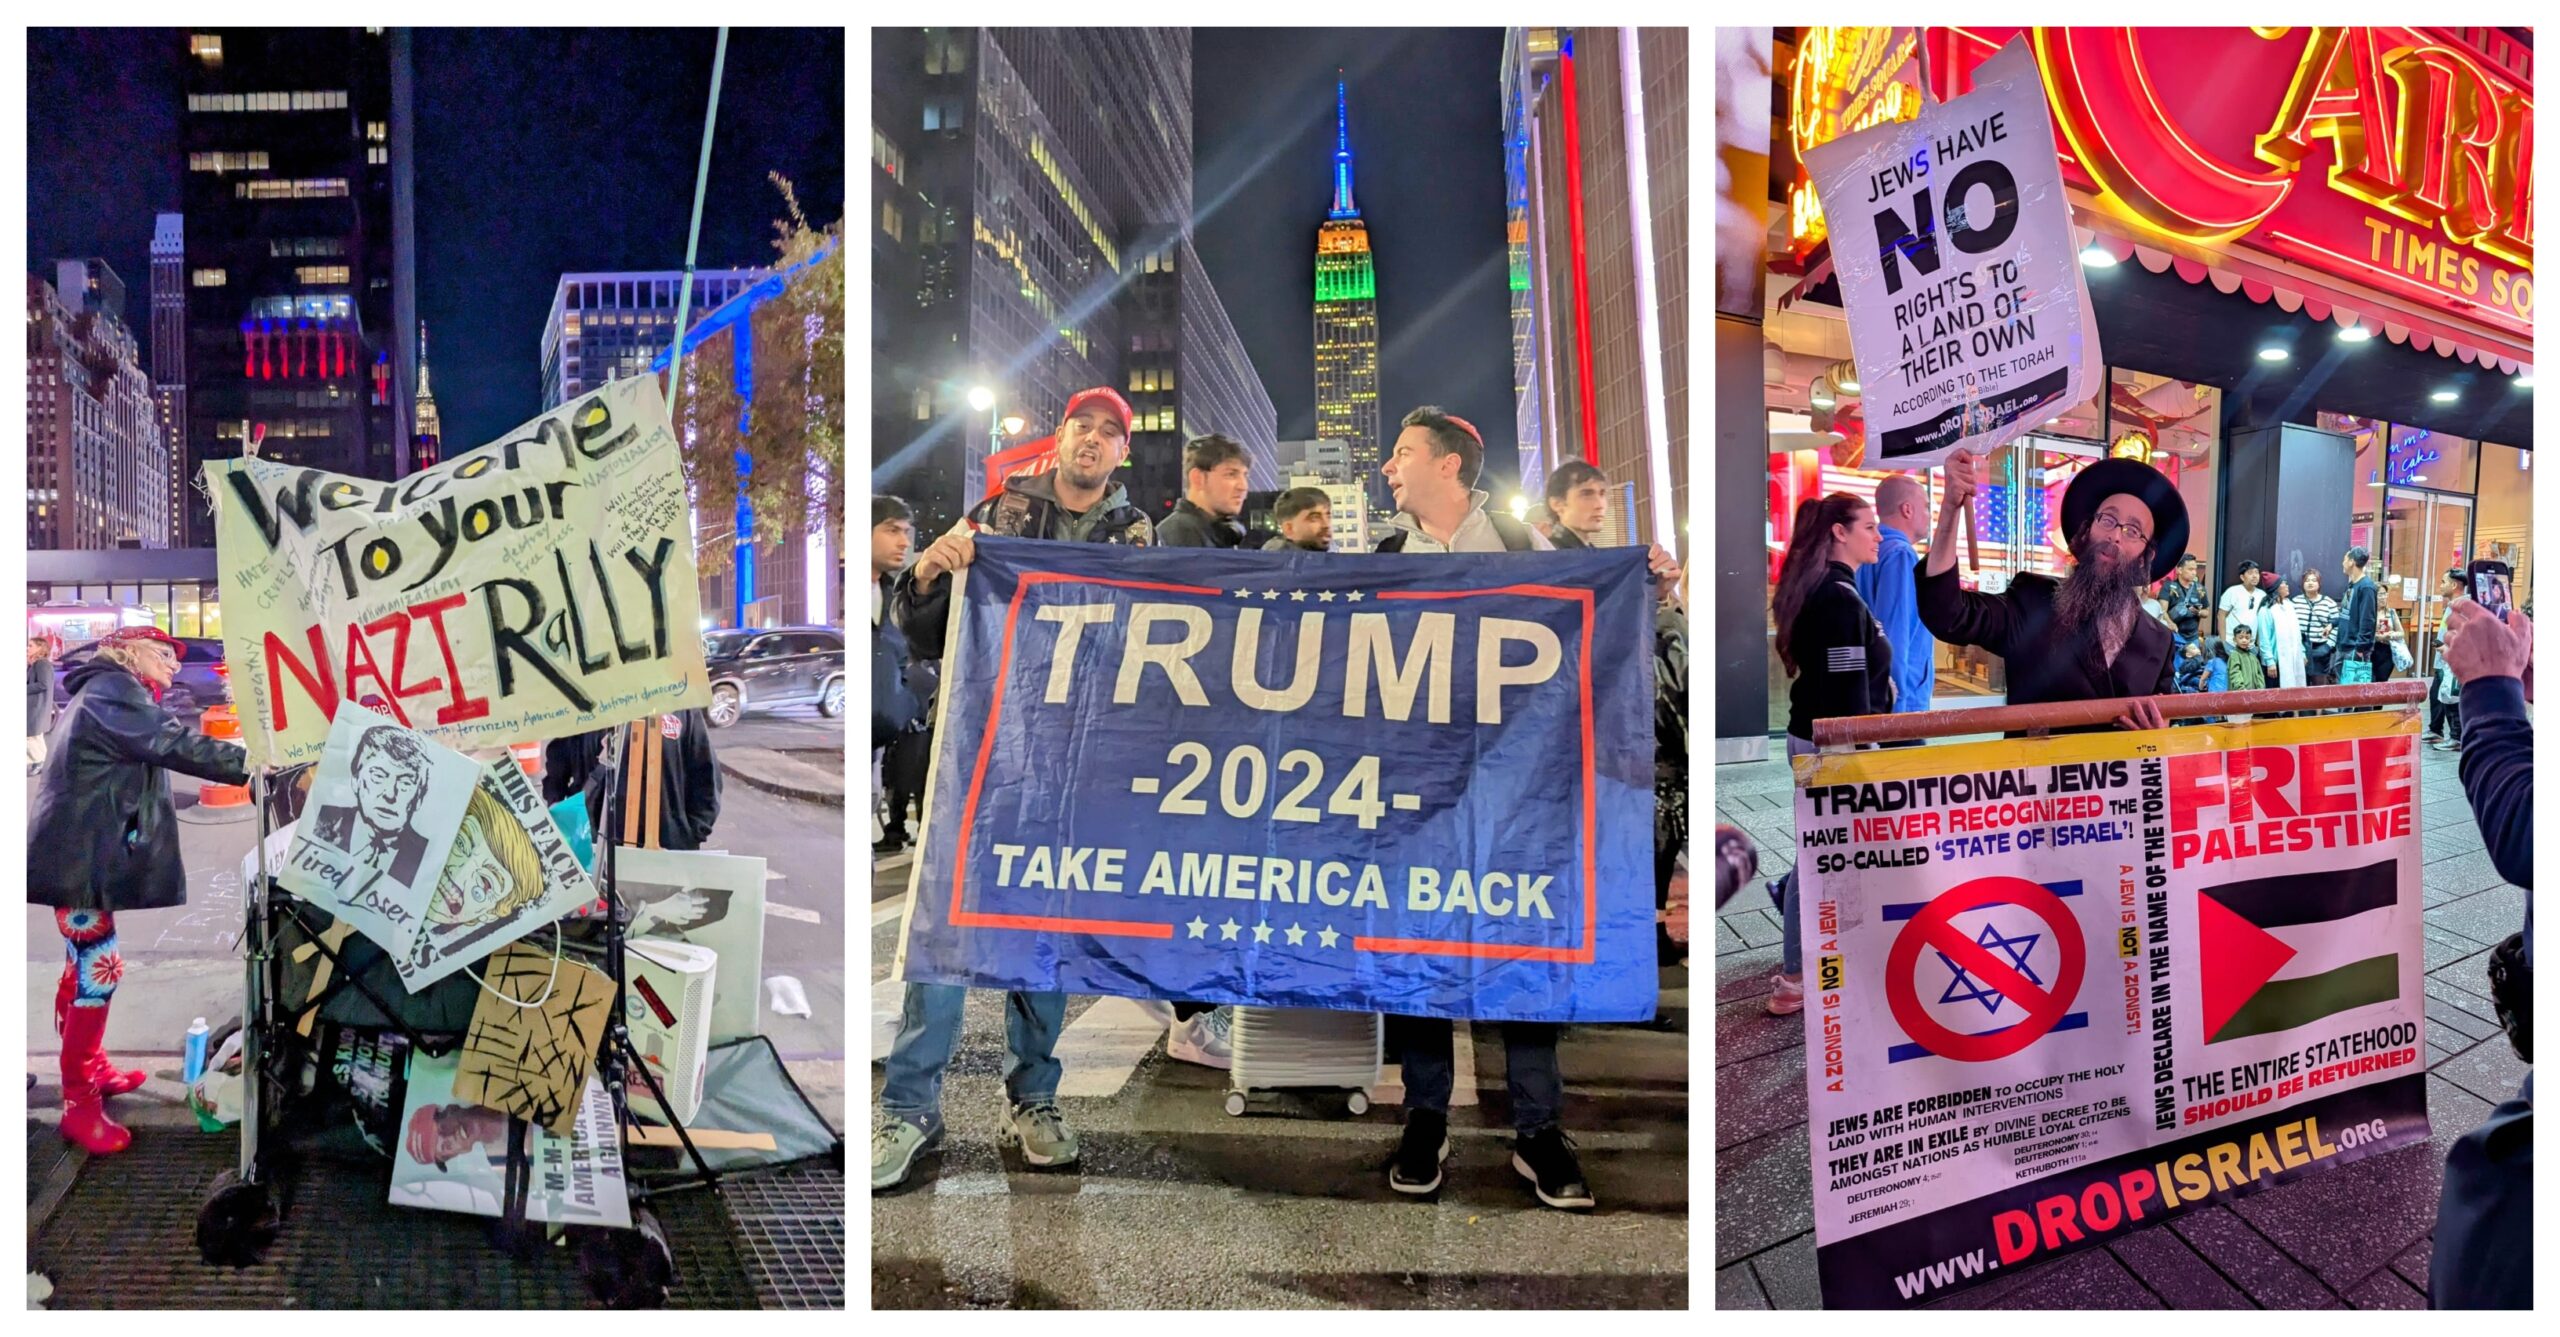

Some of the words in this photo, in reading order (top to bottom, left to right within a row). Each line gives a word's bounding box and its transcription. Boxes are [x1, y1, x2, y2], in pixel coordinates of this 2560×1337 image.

[1868, 149, 1930, 203] JEWS
[1936, 112, 2008, 166] HAVE
[1873, 159, 2019, 296] NO
[2364, 216, 2479, 294] TIMES
[1894, 271, 1977, 331] RIGHTS
[1986, 259, 2018, 289] TO
[1901, 333, 1914, 360] A
[1918, 303, 1985, 349] LAND
[1994, 285, 2027, 319] OF
[1900, 339, 1964, 388] THEIR
[1972, 314, 2036, 358] OWN
[1892, 378, 1955, 417] ACCORDING
[1958, 372, 1975, 388] TO
[1978, 362, 2008, 383] THE
[2010, 344, 2054, 374] TORAH
[226, 395, 640, 552] Welcome
[2402, 448, 2441, 473] cake
[605, 493, 626, 513] Will
[317, 526, 402, 600] To
[400, 479, 583, 593] your
[235, 557, 269, 589] HATE
[240, 637, 272, 731] MISOGYNY
[262, 592, 489, 732] NAZI
[1034, 602, 1563, 724] TRUMP
[456, 718, 519, 737] terrorizing
[523, 707, 570, 727] Americans
[640, 672, 689, 702] democracy
[284, 747, 303, 760] We
[1131, 741, 1422, 830] -2024-
[1805, 769, 2038, 817] TRADITIONAL
[2047, 761, 2129, 793] JEWS
[2140, 757, 2164, 824] TORAH:
[2168, 734, 2413, 834] FREE
[493, 750, 540, 816] THIS
[530, 817, 586, 891] FACE
[1803, 827, 1848, 849] HAVE
[1853, 811, 1941, 843] NEVER
[1949, 794, 2104, 838] RECOGNIZED
[2109, 798, 2138, 816] THE
[2143, 827, 2165, 863] THE
[2171, 805, 2411, 870] PALESTINE
[289, 835, 353, 890] Tired
[1817, 846, 1930, 874] SO-CALLED
[2016, 828, 2045, 849] OF
[2119, 864, 2134, 876] A
[2145, 865, 2168, 889] OF
[993, 843, 1128, 893] TAKE
[1139, 850, 1390, 910] AMERICA
[1408, 867, 1555, 920] BACK
[2119, 878, 2136, 908] JEW
[1818, 899, 1837, 936] JEW!
[1820, 939, 1838, 951] A
[2120, 909, 2137, 924] IS
[2121, 926, 2138, 957] NOT
[2146, 890, 2169, 944] NAME
[1821, 954, 1840, 991] NOT
[2123, 961, 2139, 972] A
[2149, 944, 2170, 982] THE
[1822, 993, 1841, 1010] IS
[2123, 975, 2142, 1036] ZIONIST!
[2150, 983, 2172, 1004] IN
[1823, 1014, 1843, 1078] ZIONIST
[2151, 1004, 2175, 1085] DECLARE
[2182, 1071, 2225, 1102] THE
[2231, 1051, 2300, 1092] ENTIRE
[2305, 1021, 2417, 1070] STATEHOOD
[1826, 1079, 1844, 1093] A
[1827, 1112, 1868, 1138] JEWS
[1872, 1104, 1903, 1127] ARE
[1907, 1085, 1992, 1118] FORBIDDEN
[1995, 1086, 2012, 1098] TO
[2015, 1074, 2064, 1095] OCCUPY
[2067, 1070, 2091, 1084] THE
[2094, 1064, 2126, 1079] HOLY
[2154, 1085, 2176, 1131] JEWS
[2183, 1086, 2273, 1127] SHOULD
[2277, 1075, 2304, 1100] BE
[2308, 1047, 2416, 1090] RETURNED
[1828, 1133, 1866, 1152] LAND
[1869, 1123, 1905, 1141] WITH
[1908, 1109, 1957, 1132] HUMAN
[1962, 1087, 2064, 1119] INTERVENTIONS
[1828, 1153, 1868, 1177] THEY
[1872, 1143, 1904, 1167] ARE
[1908, 1139, 1924, 1158] IN
[1928, 1125, 1969, 1152] EXILE
[1972, 1125, 1989, 1138] BY
[1995, 1115, 2036, 1134] DIVINE
[2041, 1105, 2090, 1125] DECREE
[2092, 1100, 2108, 1113] TO
[2111, 1096, 2127, 1109] BE
[2014, 1133, 2080, 1156] DEUTERONOMY
[570, 1118, 596, 1206] AMERICA
[1829, 1162, 1898, 1192] AMONGST
[1902, 1146, 1959, 1171] NATIONS
[1963, 1140, 1980, 1155] AS
[1983, 1127, 2036, 1149] HUMBLE
[2039, 1120, 2076, 1137] LOYAL
[2078, 1106, 2132, 1127] CITIZENS
[2014, 1144, 2080, 1166] DEUTERONOMY
[2015, 1157, 2070, 1180] KETHUBOTH
[1847, 1175, 1922, 1205] DEUTERONOMY
[1848, 1201, 1899, 1225] JEREMIAH
